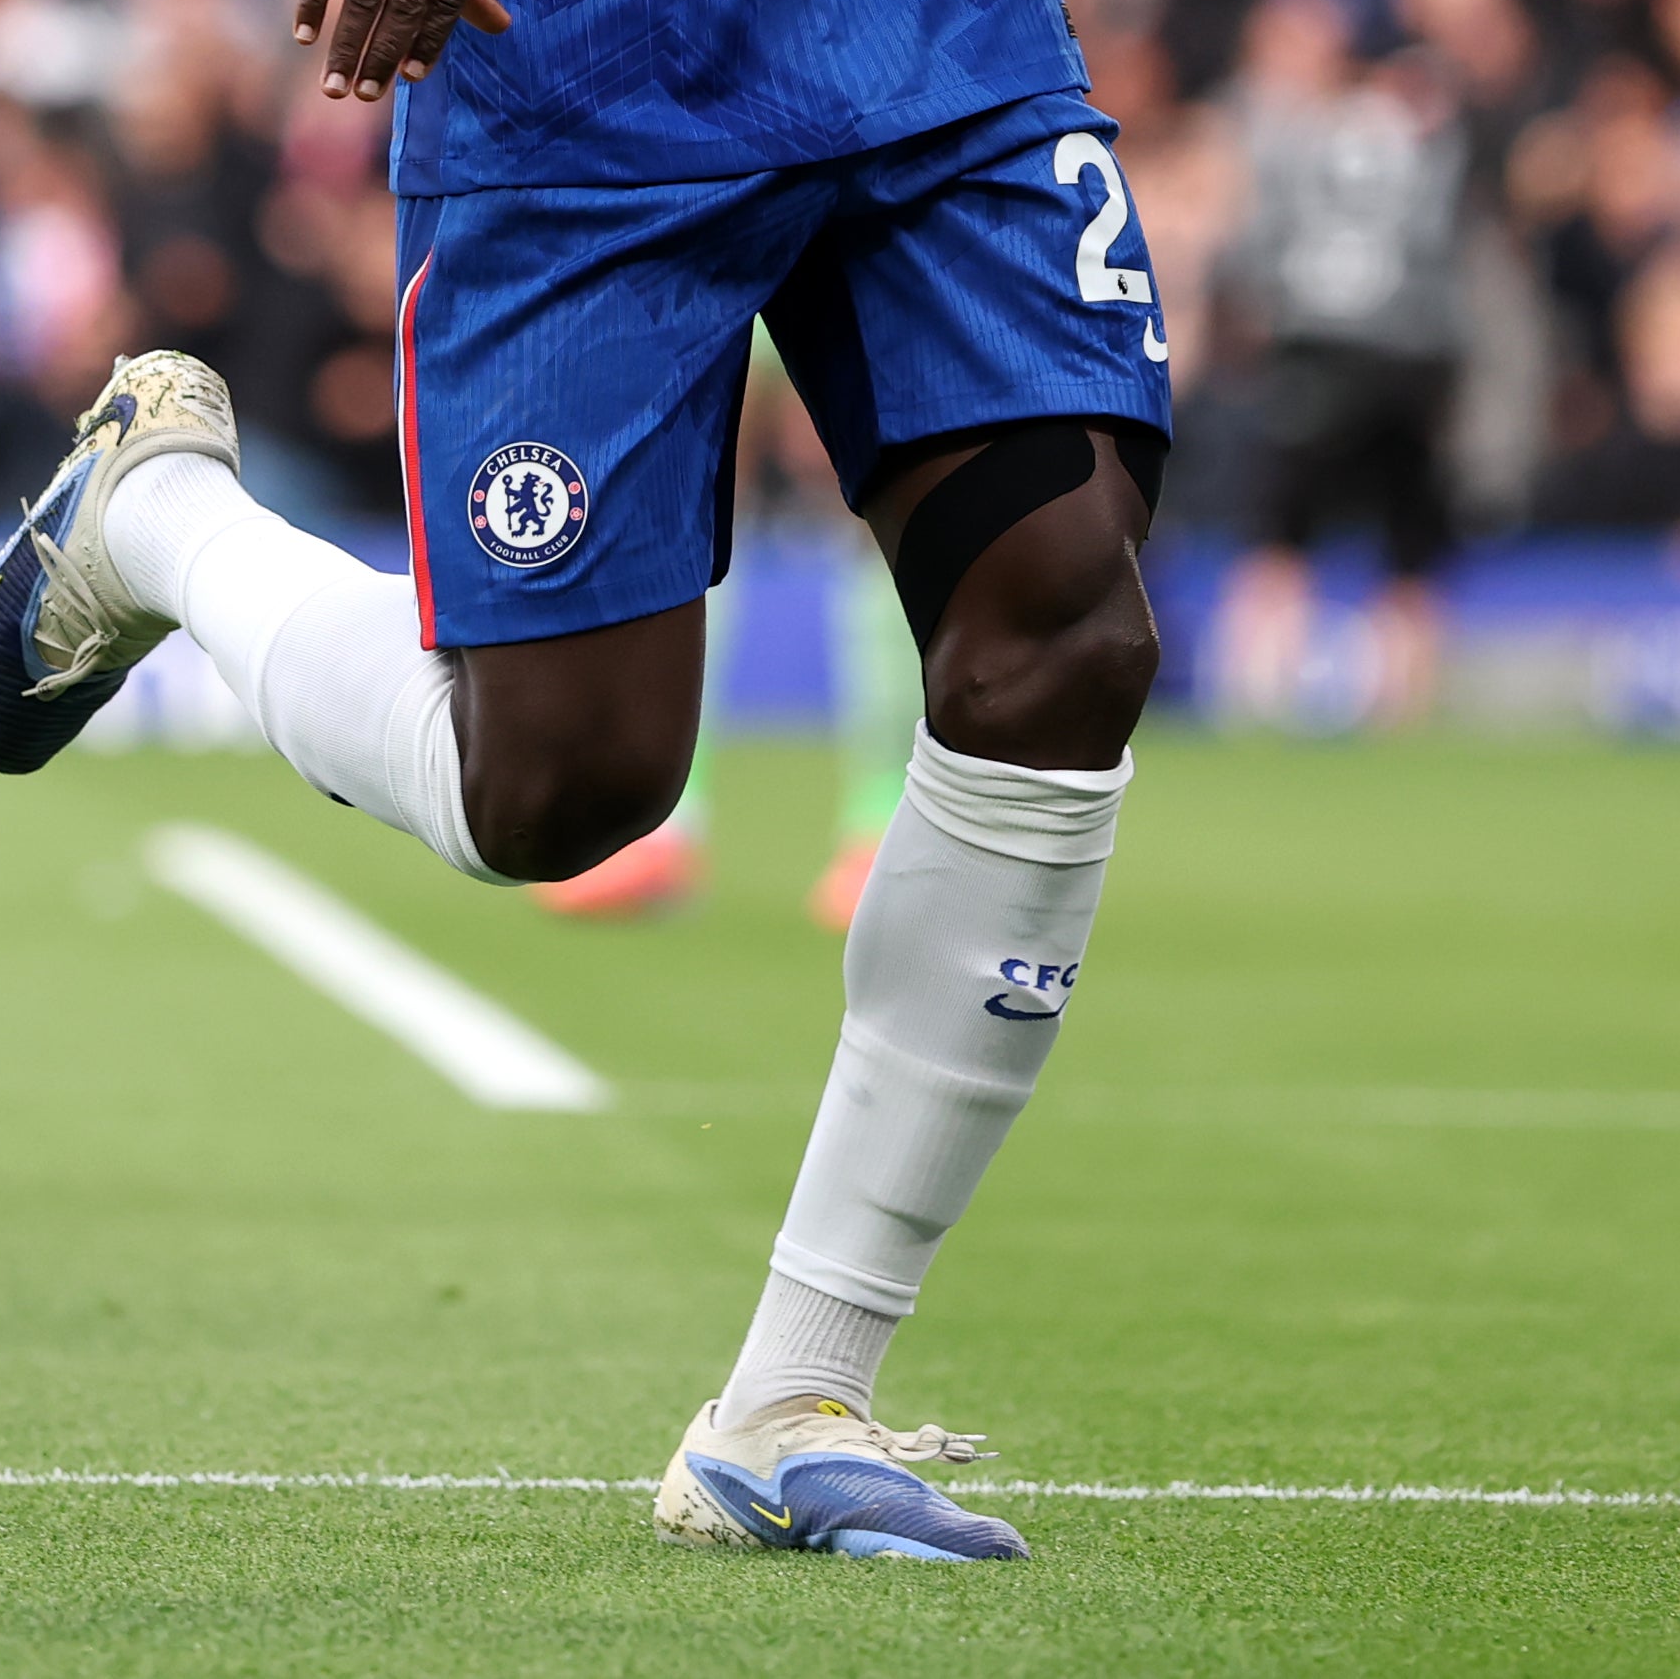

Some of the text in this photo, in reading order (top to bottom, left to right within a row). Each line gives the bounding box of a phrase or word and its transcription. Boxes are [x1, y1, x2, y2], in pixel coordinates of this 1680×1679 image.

[1053, 131, 1153, 304] 2
[486, 447, 563, 476] CHELSEA
[489, 534, 570, 561] FOOTBALL CLUB
[998, 957, 1080, 992] CFC
